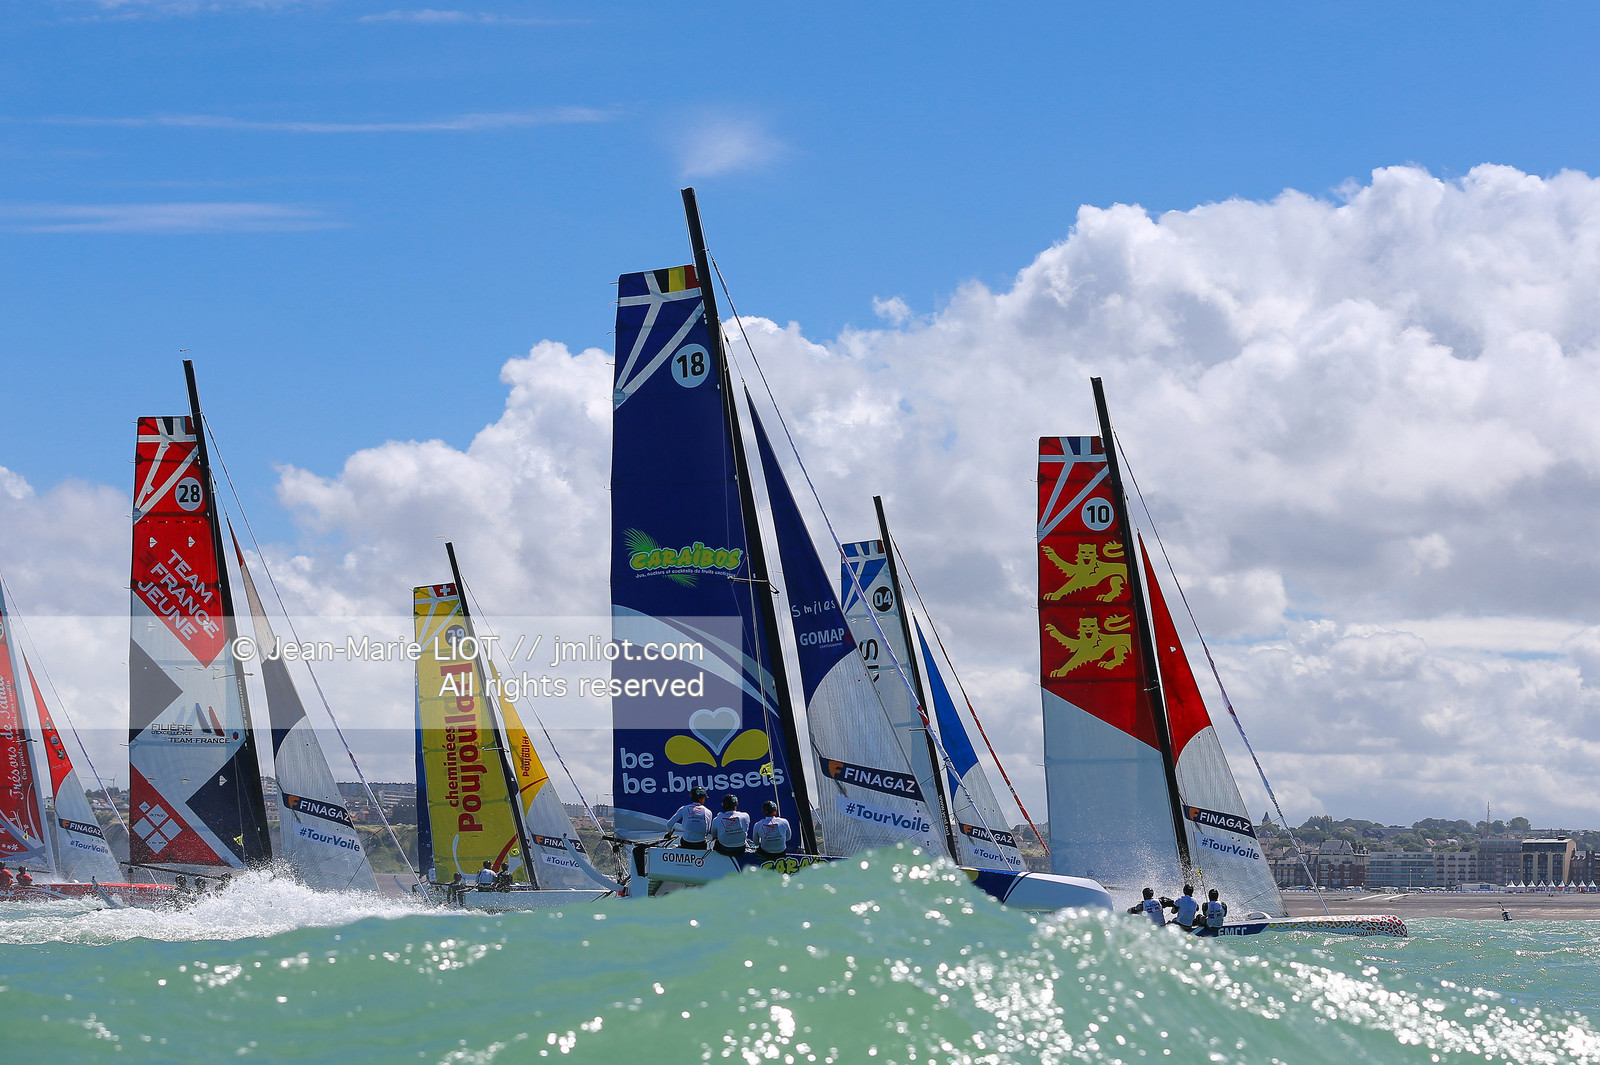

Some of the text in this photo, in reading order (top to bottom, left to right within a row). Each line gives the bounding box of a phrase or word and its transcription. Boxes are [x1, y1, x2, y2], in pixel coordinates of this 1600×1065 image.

[676, 351, 705, 379] 18
[178, 484, 201, 503] 28
[1086, 504, 1110, 524] 10
[167, 549, 213, 603] TEAM
[150, 562, 220, 639] FRANCE
[874, 590, 893, 607] 04
[137, 581, 198, 641] JEUNE
[442, 725, 460, 808] cheminées
[620, 747, 654, 769] be
[622, 772, 657, 794] be
[844, 767, 916, 793] FINAGAZ
[299, 800, 350, 822] FINAGAZ
[845, 802, 930, 833] #TourVoile
[1199, 811, 1251, 832] FINAGAZ
[70, 822, 102, 836] FINAGAZ
[299, 827, 360, 852] #TourVoile
[662, 852, 696, 864] GOMAP
[1201, 837, 1260, 860] #TourVoile
